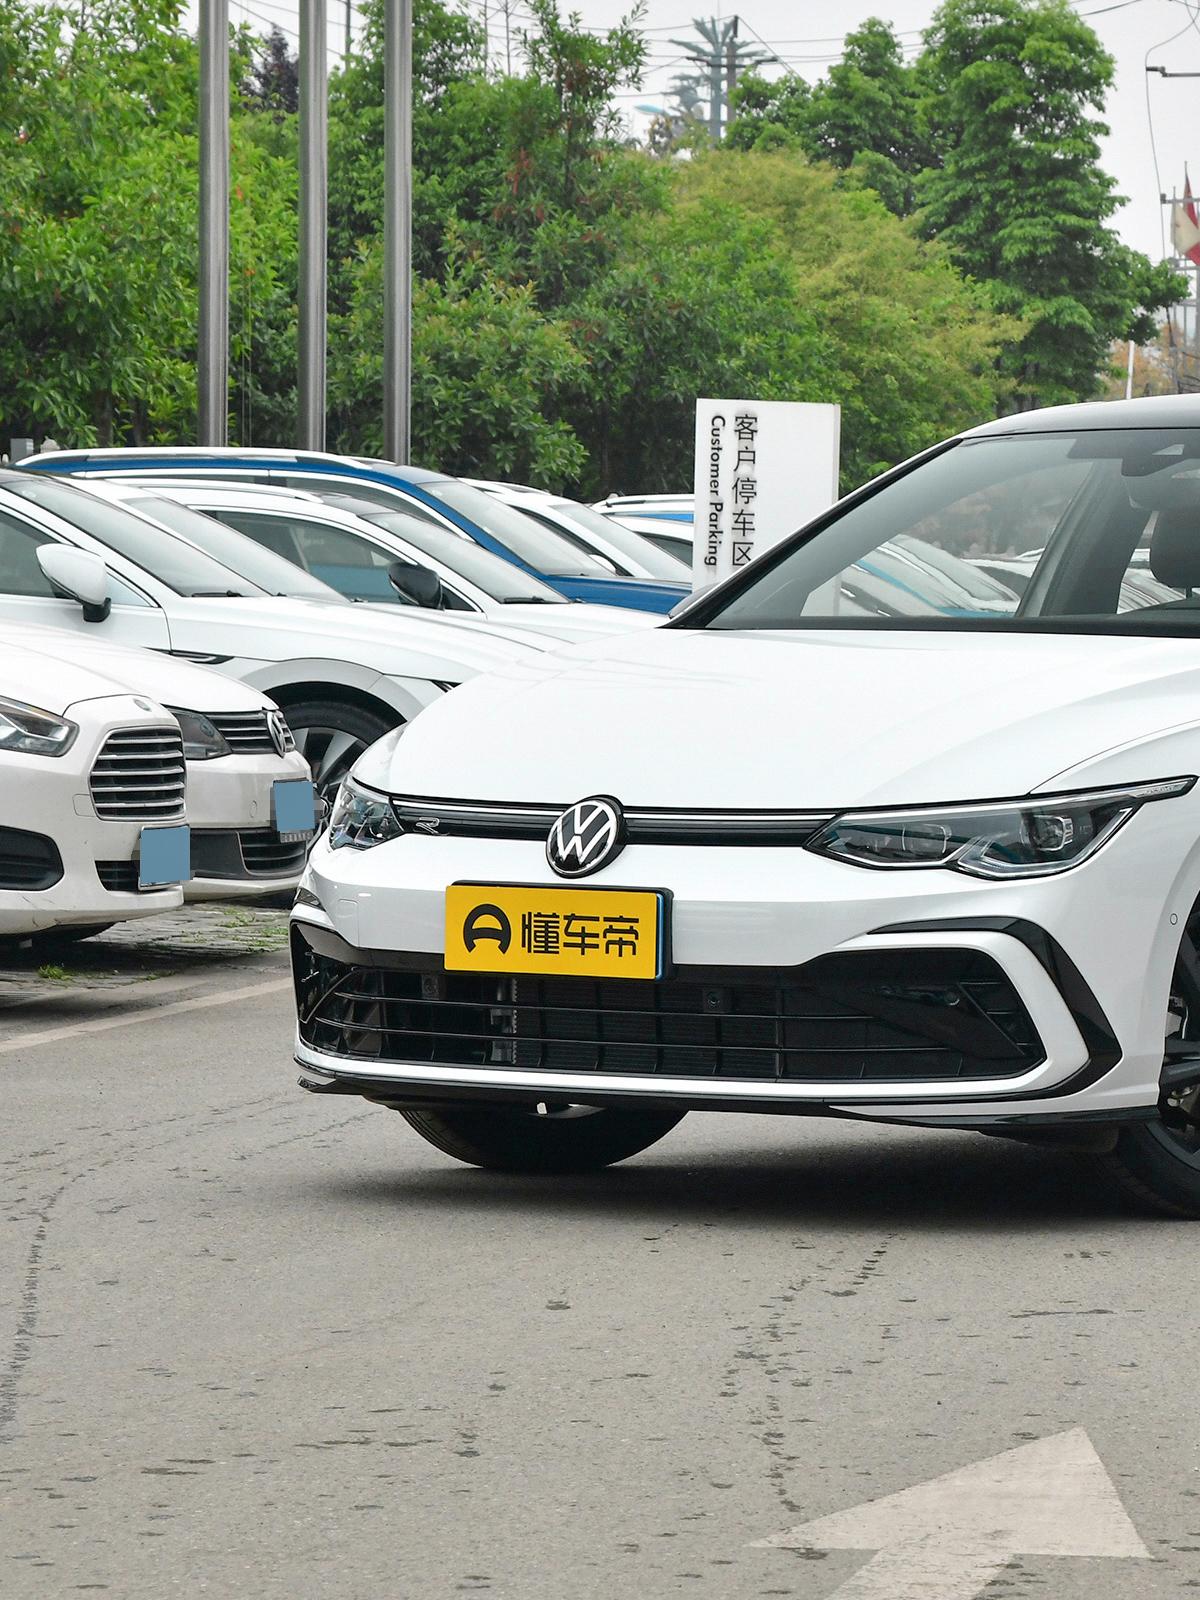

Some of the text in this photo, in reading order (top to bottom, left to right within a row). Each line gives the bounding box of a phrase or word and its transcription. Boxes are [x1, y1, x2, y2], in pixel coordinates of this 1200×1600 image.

[704, 415, 726, 566] Customer Parking
[732, 414, 758, 566] 客户停车区
[547, 800, 617, 874] VW
[521, 911, 640, 958] 懂车帝
